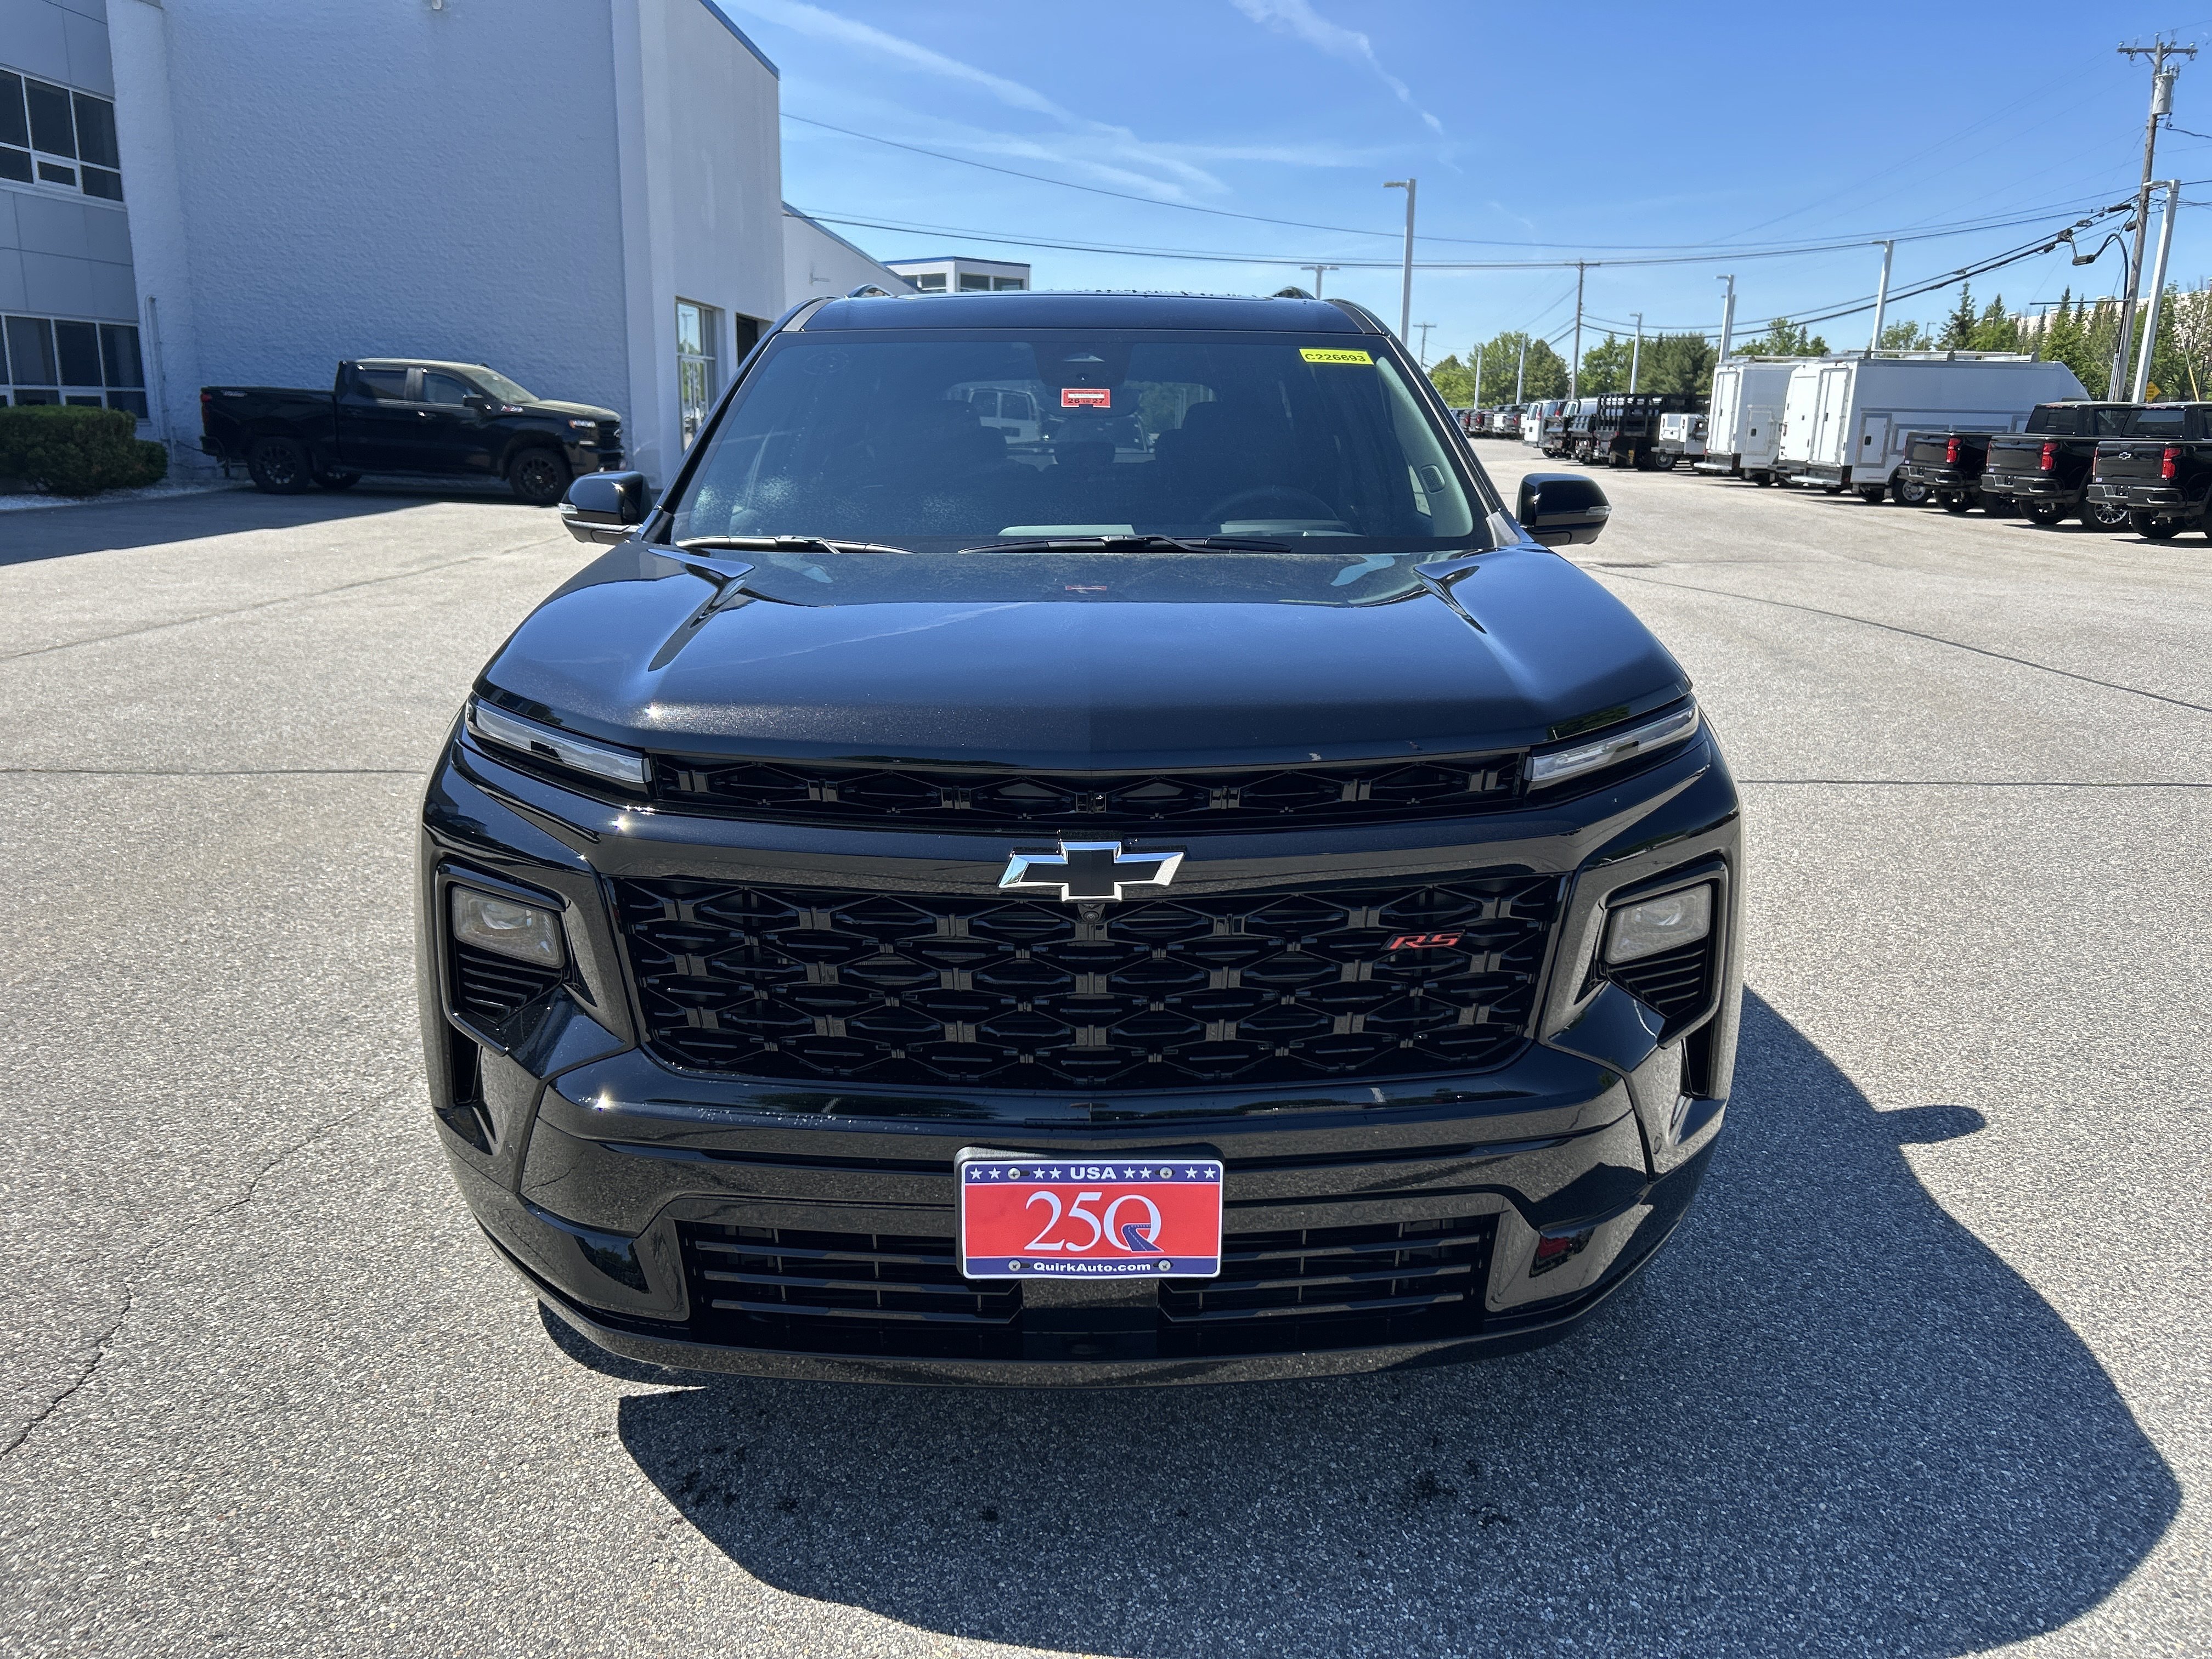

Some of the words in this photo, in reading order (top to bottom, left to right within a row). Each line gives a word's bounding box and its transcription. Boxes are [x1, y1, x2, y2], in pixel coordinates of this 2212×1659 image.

[1305, 353, 1366, 362] C226693
[1389, 932, 1463, 950] RS
[1069, 1167, 1117, 1180] USA
[1033, 1261, 1151, 1273] QuirkAuto.com
